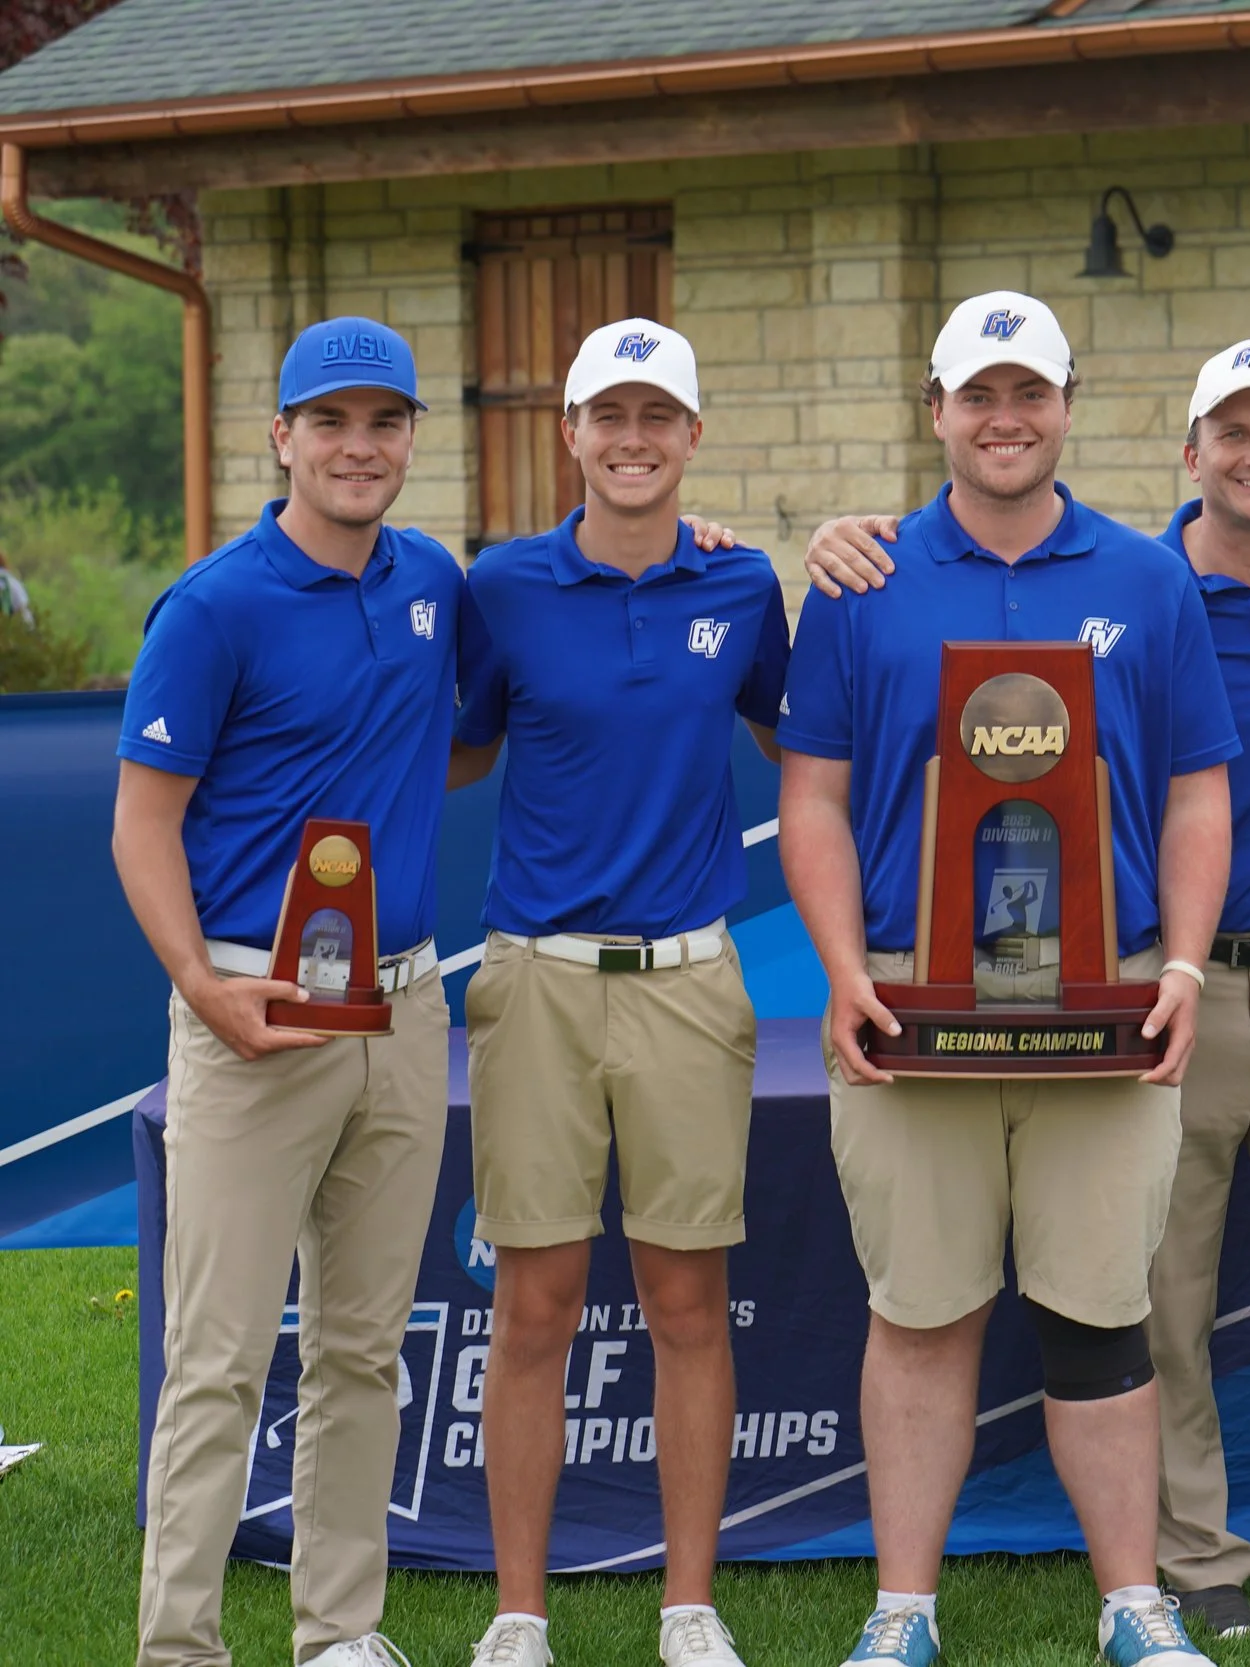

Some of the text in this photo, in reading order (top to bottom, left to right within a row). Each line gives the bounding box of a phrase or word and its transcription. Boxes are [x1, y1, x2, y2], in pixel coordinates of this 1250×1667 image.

[980, 309, 1026, 341] GV
[323, 334, 391, 363] GVSU
[614, 333, 660, 362] GV
[409, 599, 437, 640] GV
[687, 617, 730, 659] GV
[1077, 616, 1127, 658] GV
[970, 726, 1065, 755] NCAA
[982, 827, 1040, 842] DIVISION
[936, 1031, 1105, 1051] REGIONAL CHAMPION
[452, 1340, 628, 1413] GF
